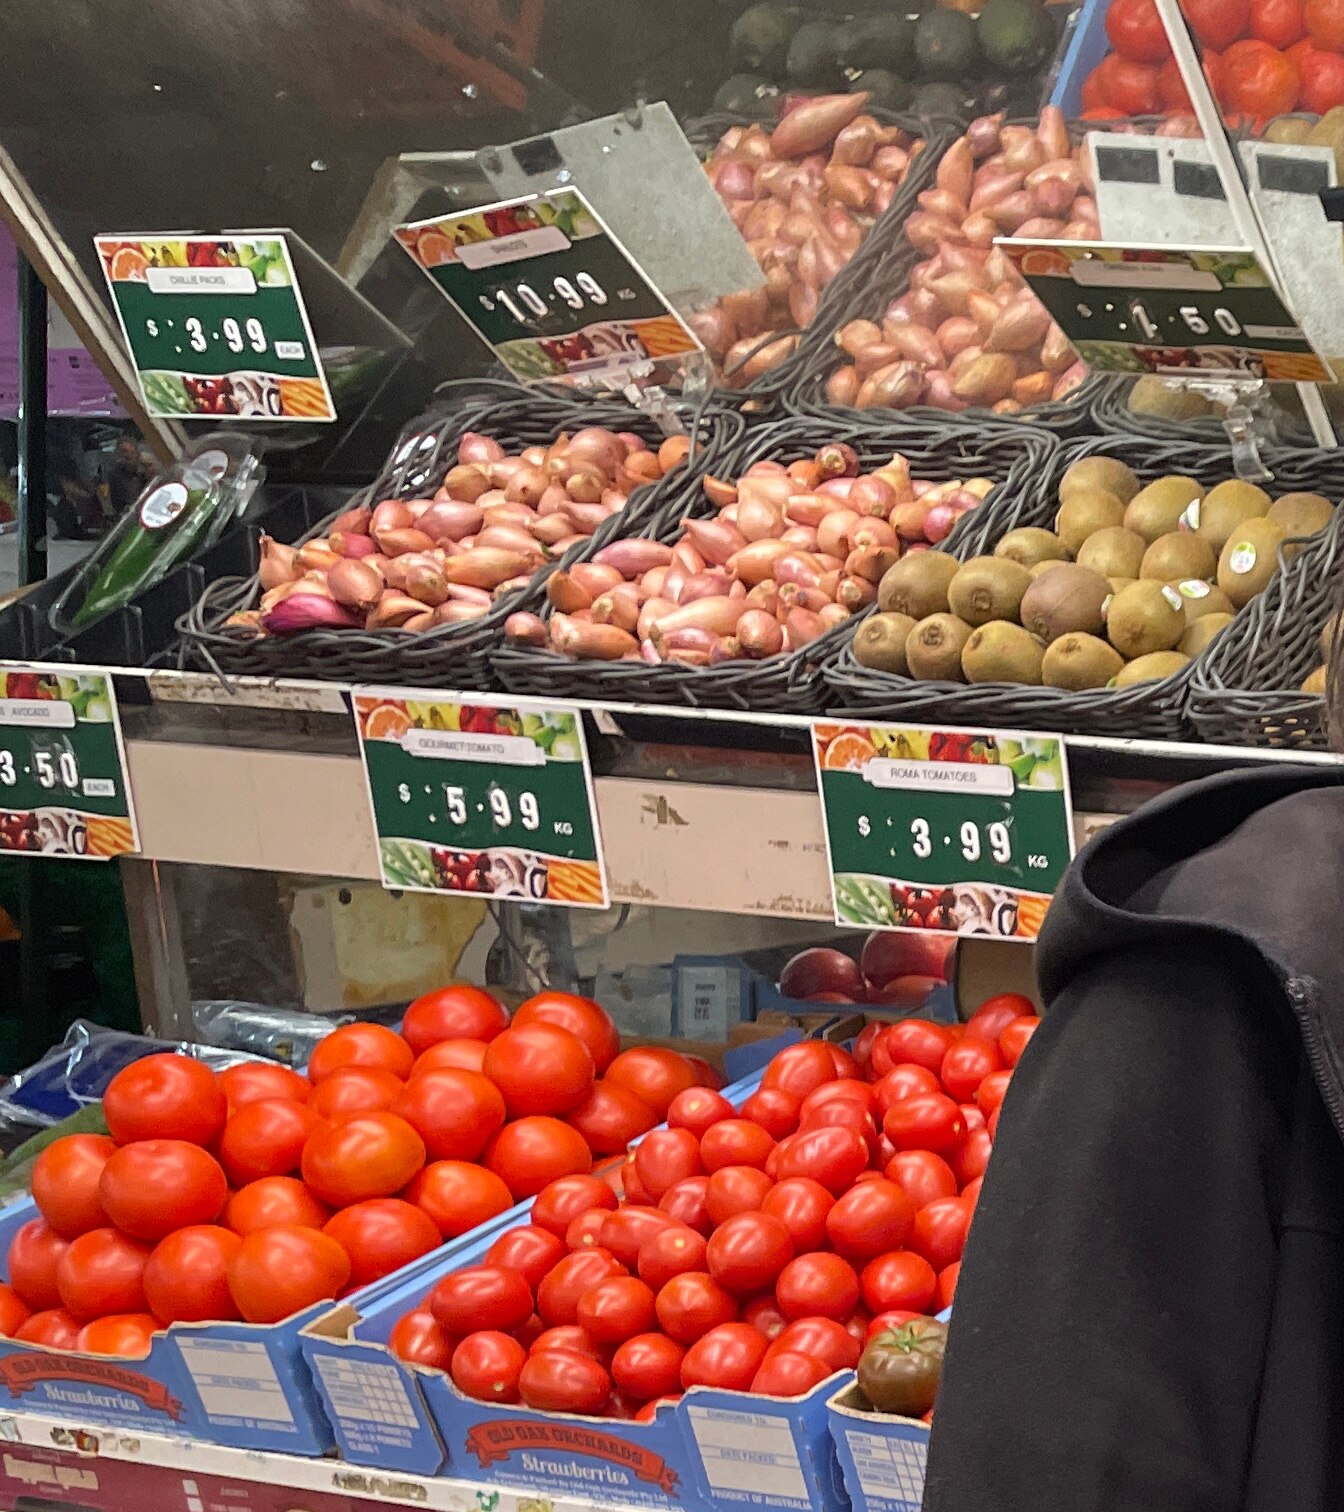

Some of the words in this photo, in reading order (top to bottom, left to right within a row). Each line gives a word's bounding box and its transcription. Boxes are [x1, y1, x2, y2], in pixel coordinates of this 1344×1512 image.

[186, 317, 268, 354] 3.99
[890, 767, 920, 780] ROMA
[922, 769, 978, 783] TOMATOES
[445, 785, 541, 831] 5.99
[553, 821, 574, 836] KG
[910, 817, 1012, 864] 3.99
[1027, 855, 1049, 869] KG
[522, 1453, 630, 1486] Strawberries
[752, 1494, 762, 1505] OF
